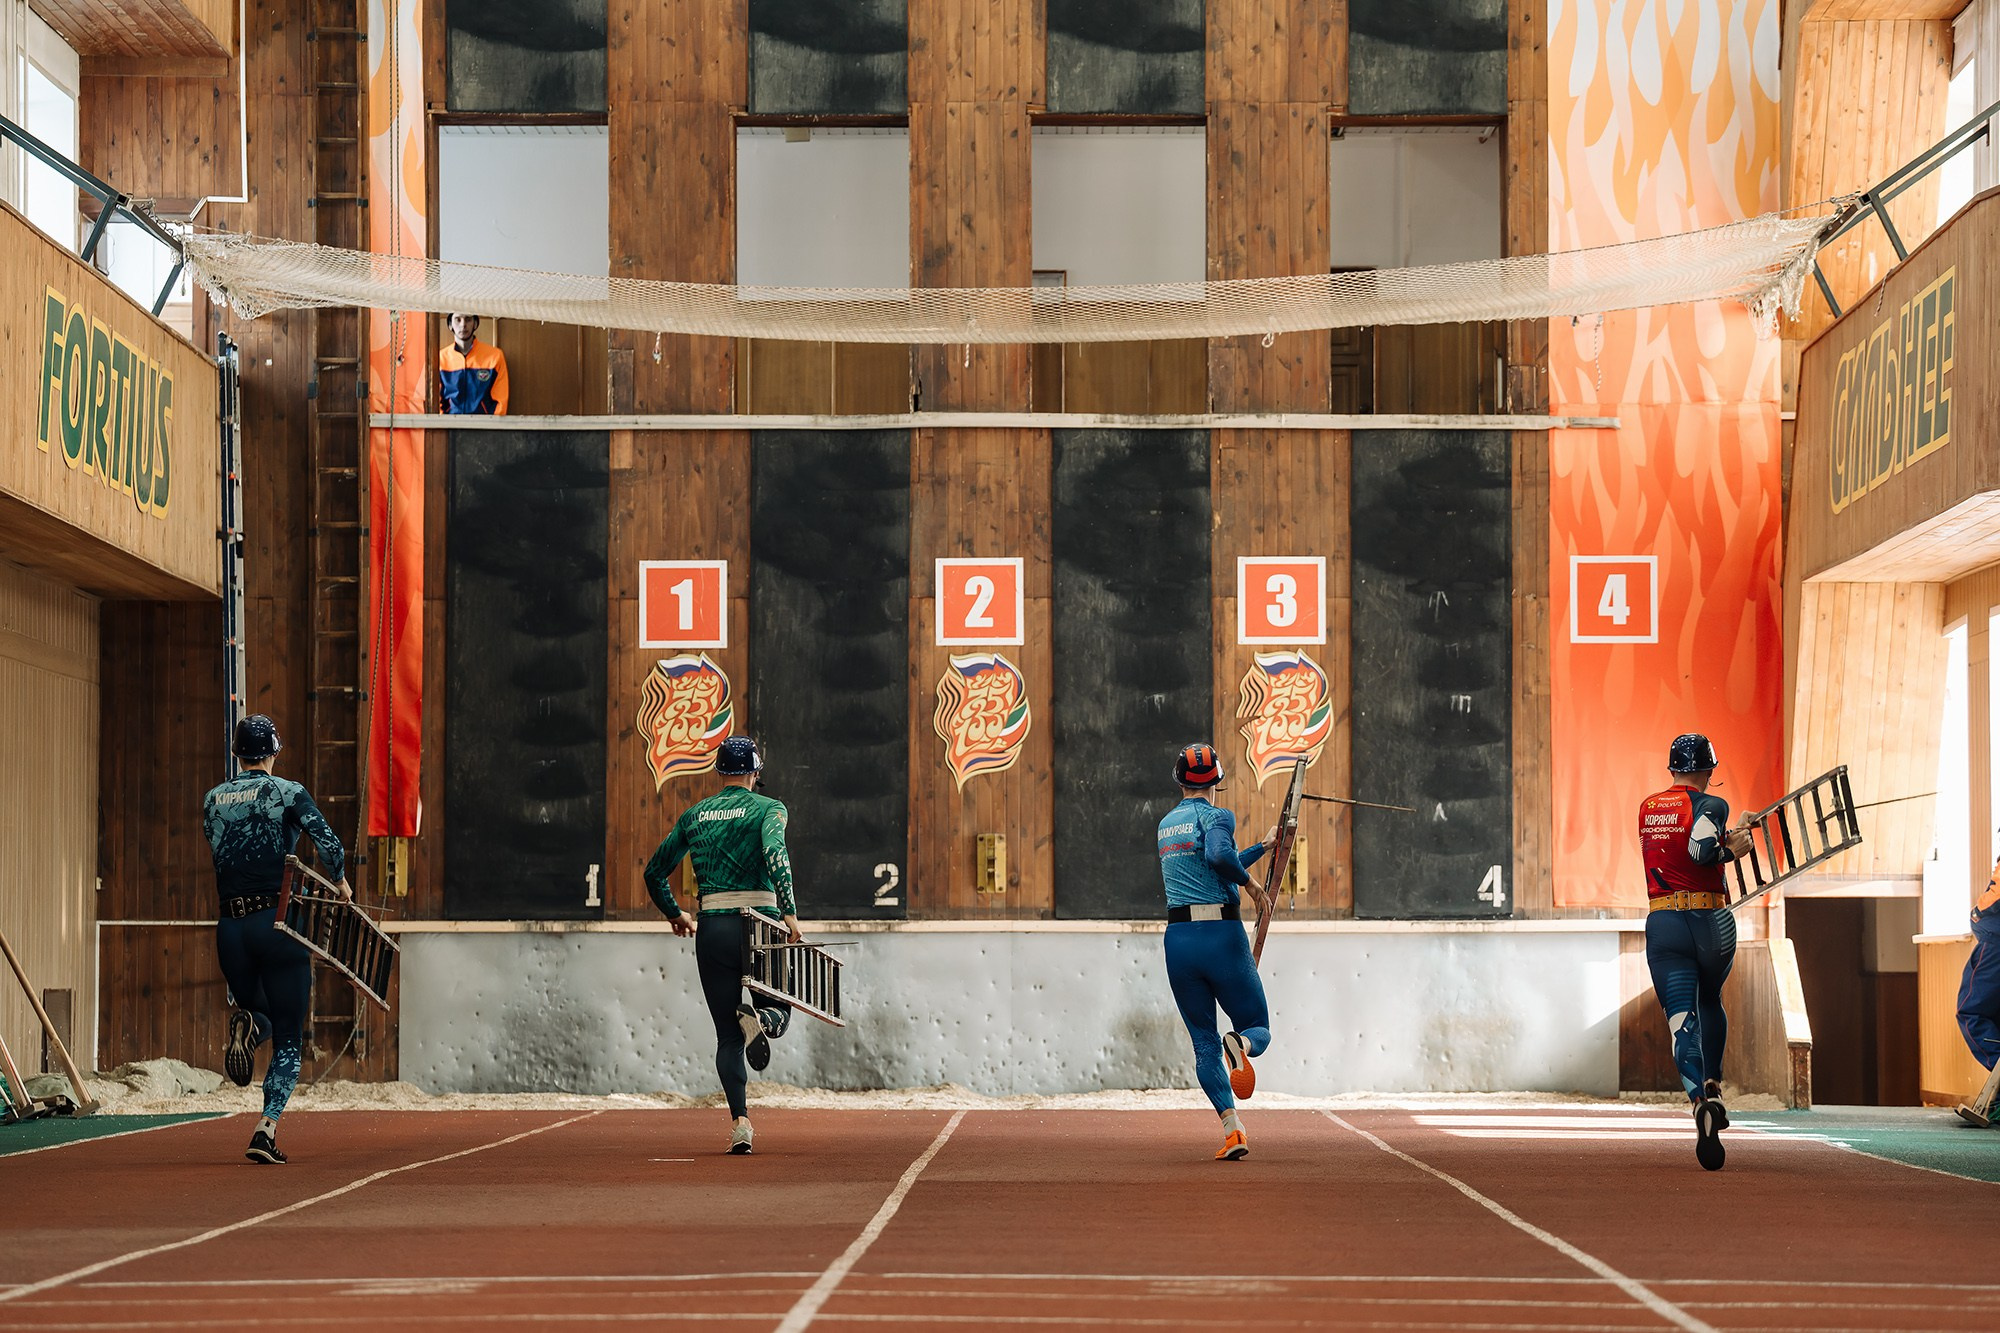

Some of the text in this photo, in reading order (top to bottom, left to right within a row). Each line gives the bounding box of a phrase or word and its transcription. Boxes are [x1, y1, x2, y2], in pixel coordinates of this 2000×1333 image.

[37, 284, 174, 520] FORTIUS
[1830, 265, 1955, 514] СИЛЬНЕЕ
[670, 578, 693, 630] 1
[964, 575, 995, 628] 2
[1266, 573, 1298, 627] 3
[1597, 574, 1631, 625] 4
[215, 788, 259, 805] КИРКИН
[698, 807, 747, 823] САМОШИН
[1645, 813, 1678, 825] КОРЯКИН
[585, 863, 601, 907] 1
[873, 863, 899, 906] 2
[1476, 864, 1506, 908] 4
